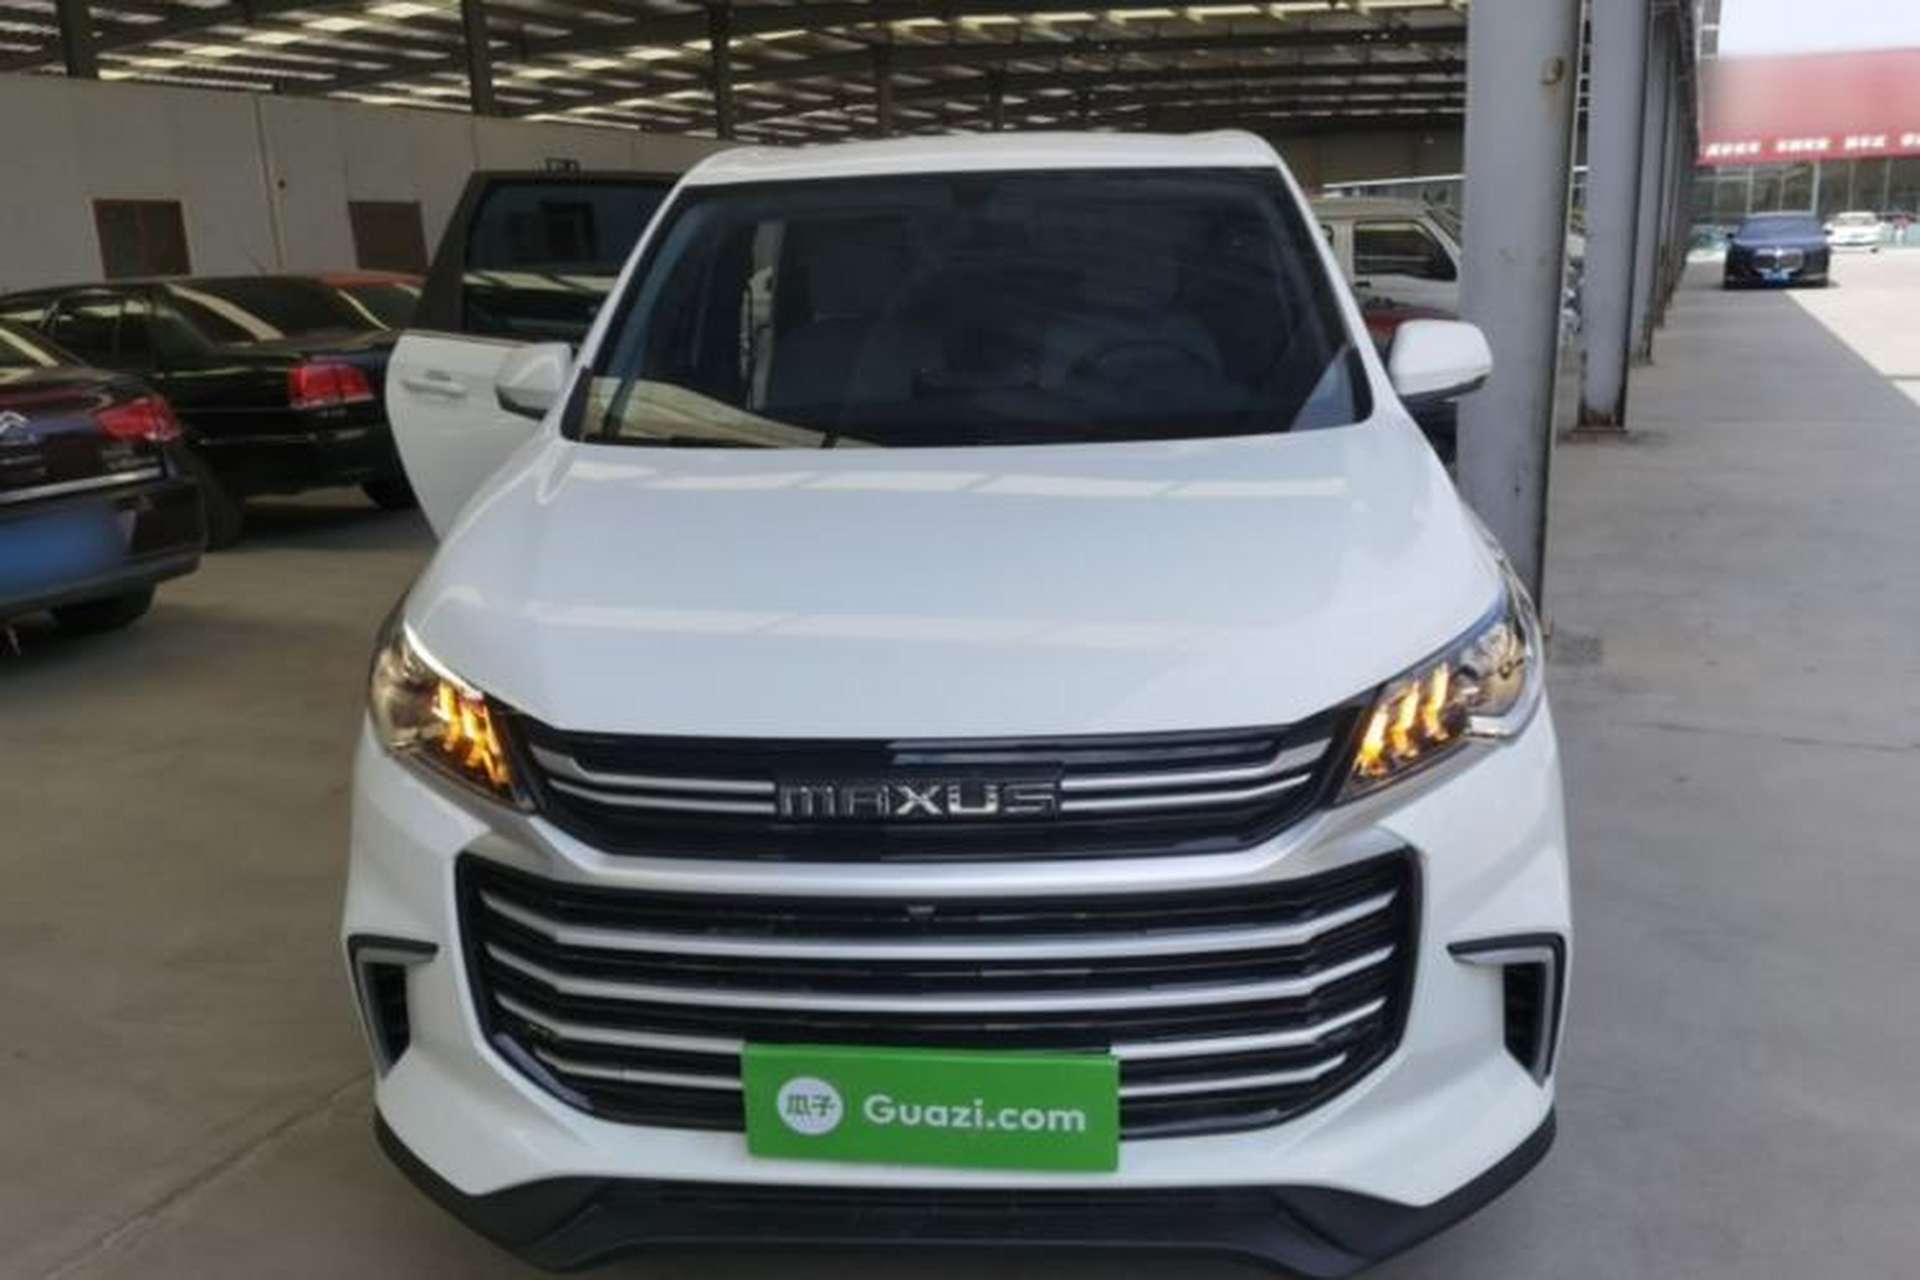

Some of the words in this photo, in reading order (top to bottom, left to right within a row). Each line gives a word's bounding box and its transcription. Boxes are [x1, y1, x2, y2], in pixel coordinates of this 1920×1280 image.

[778, 779, 1056, 816] MAXUS
[786, 1093, 836, 1118] 瓜子
[863, 1093, 1087, 1133] Guazi.com
